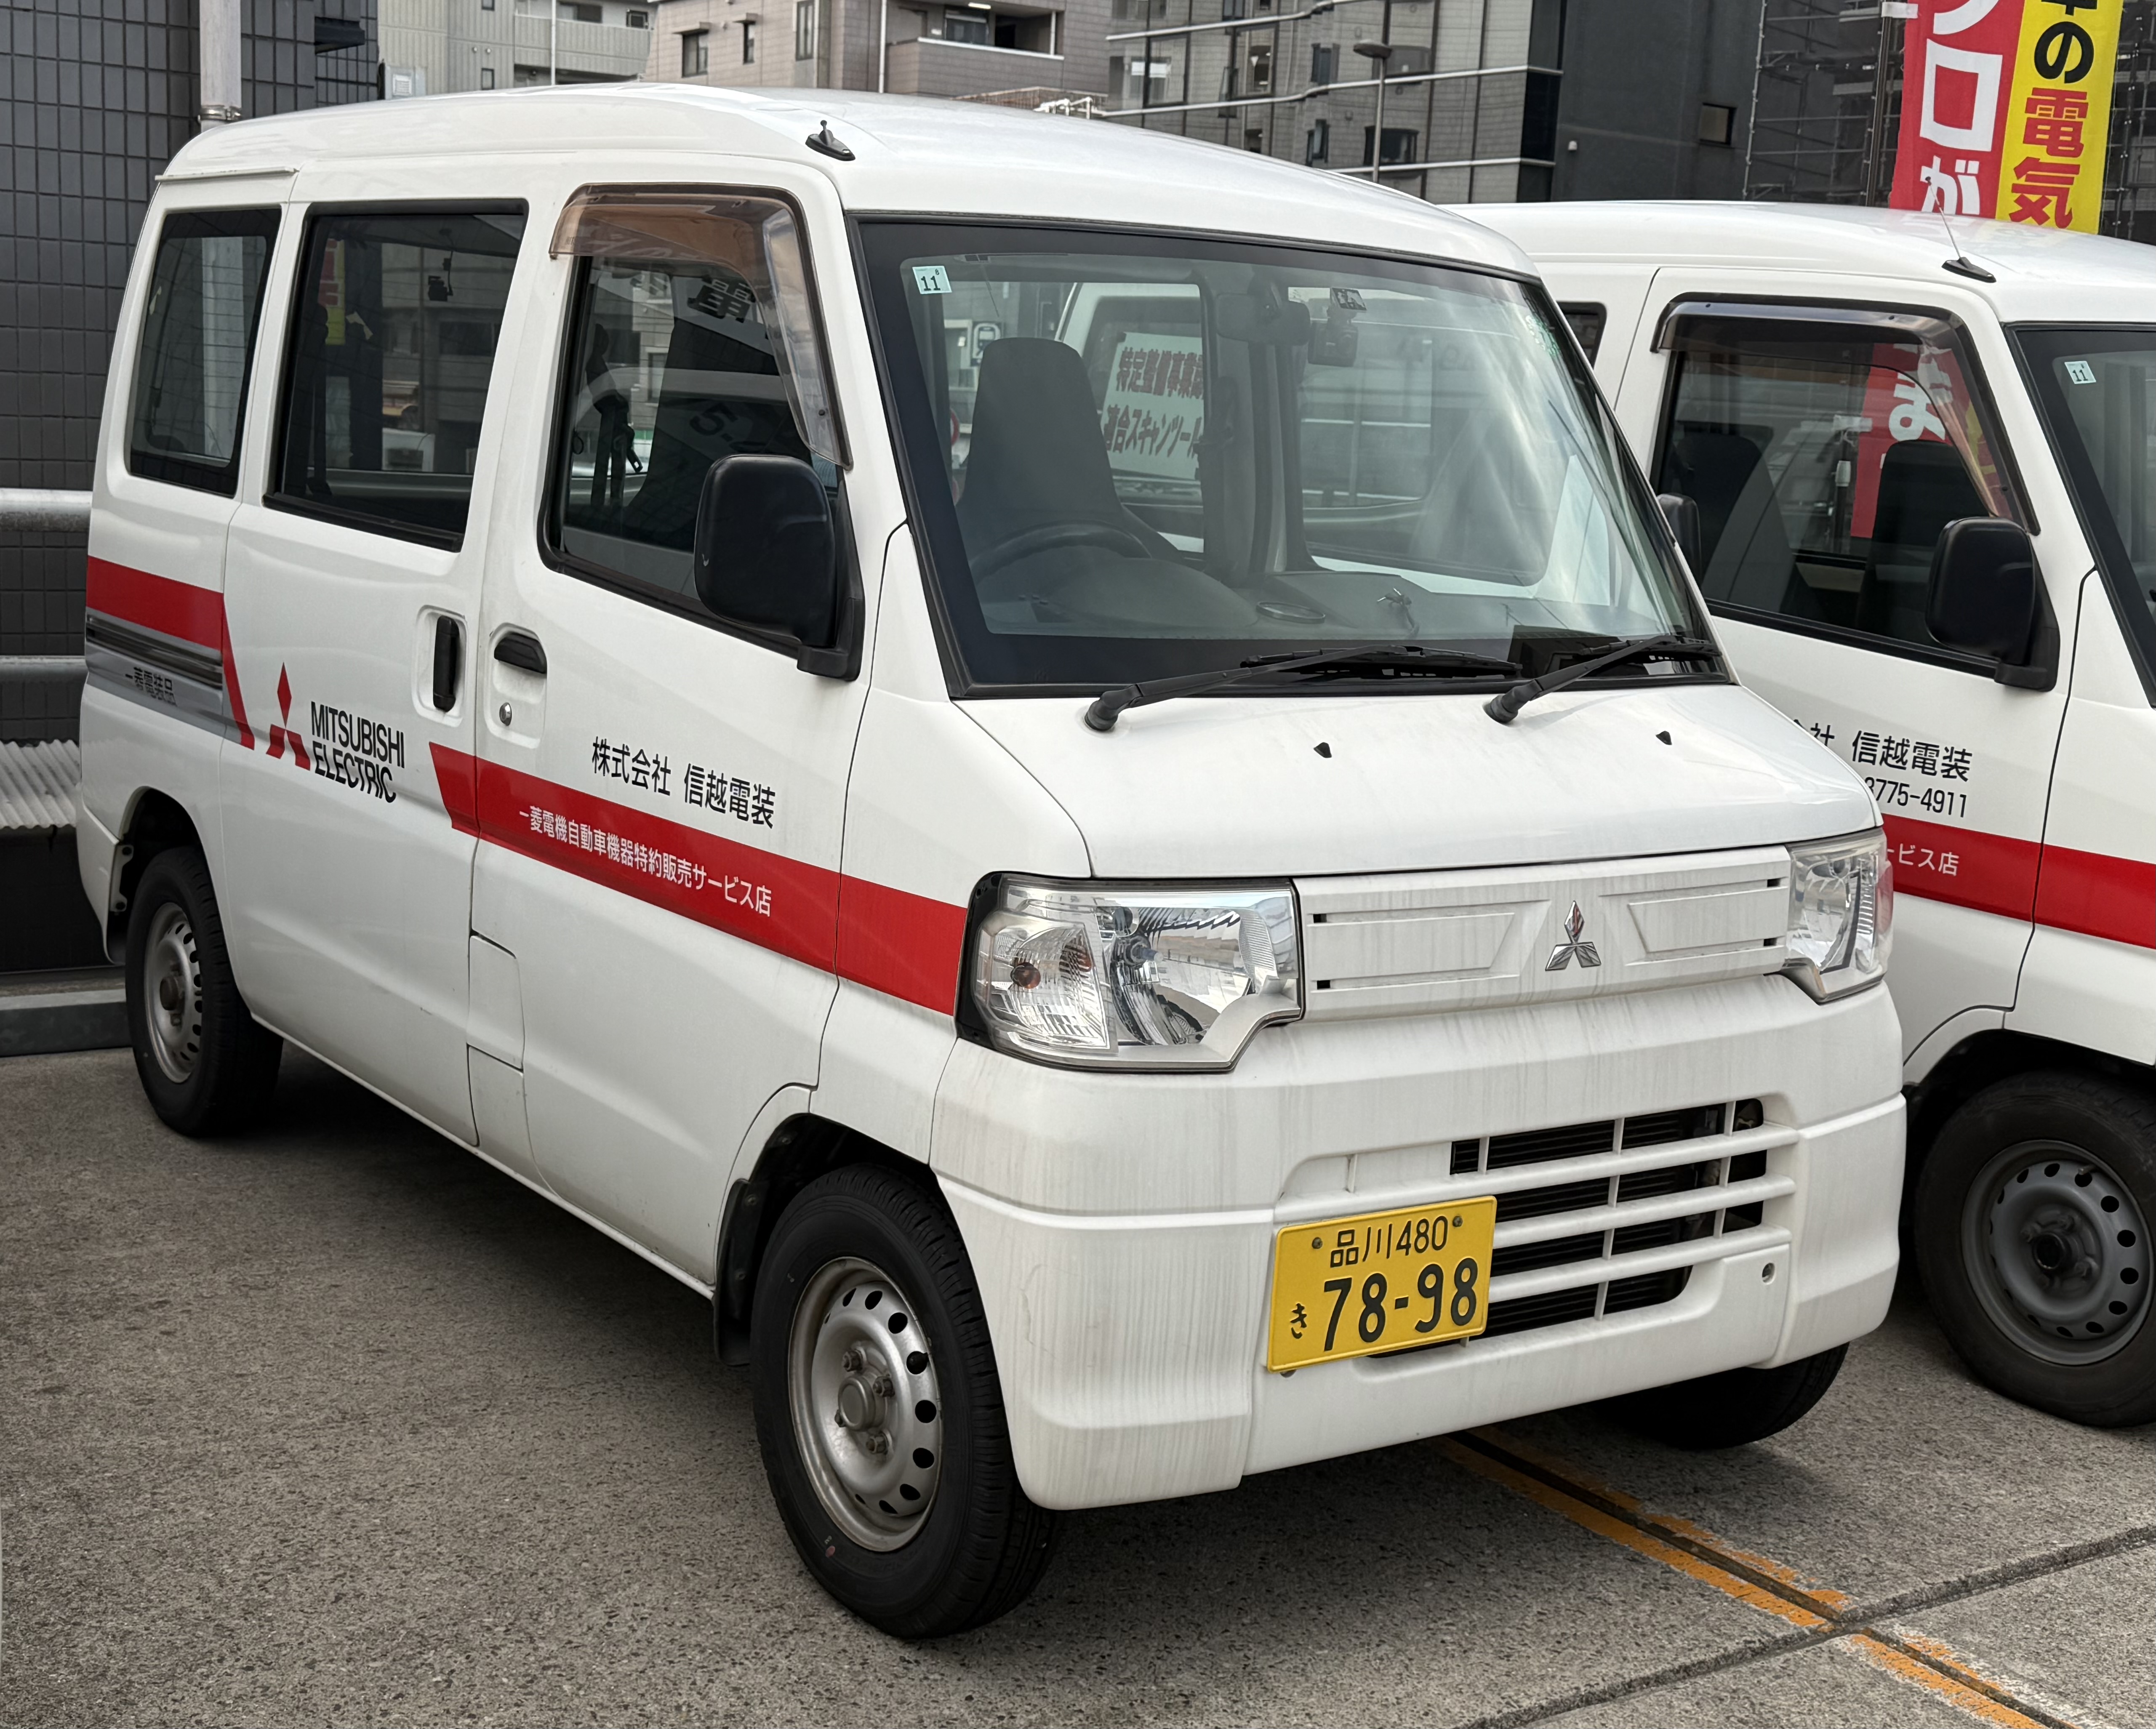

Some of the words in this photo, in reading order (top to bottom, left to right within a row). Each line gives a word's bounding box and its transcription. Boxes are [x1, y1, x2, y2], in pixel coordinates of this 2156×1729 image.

[1919, 0, 2003, 215] ロが
[2009, 0, 2097, 229] の電気
[920, 275, 941, 291] 11
[2072, 369, 2089, 381] 11
[311, 701, 405, 768] MITSUBISHI
[1852, 730, 1972, 782] 信越電装
[312, 741, 397, 803] ELECTRIC
[592, 736, 672, 796] 株式会社
[684, 763, 776, 829] 信越電装
[1289, 1303, 1308, 1339] き
[1323, 1257, 1478, 1351] 78-98
